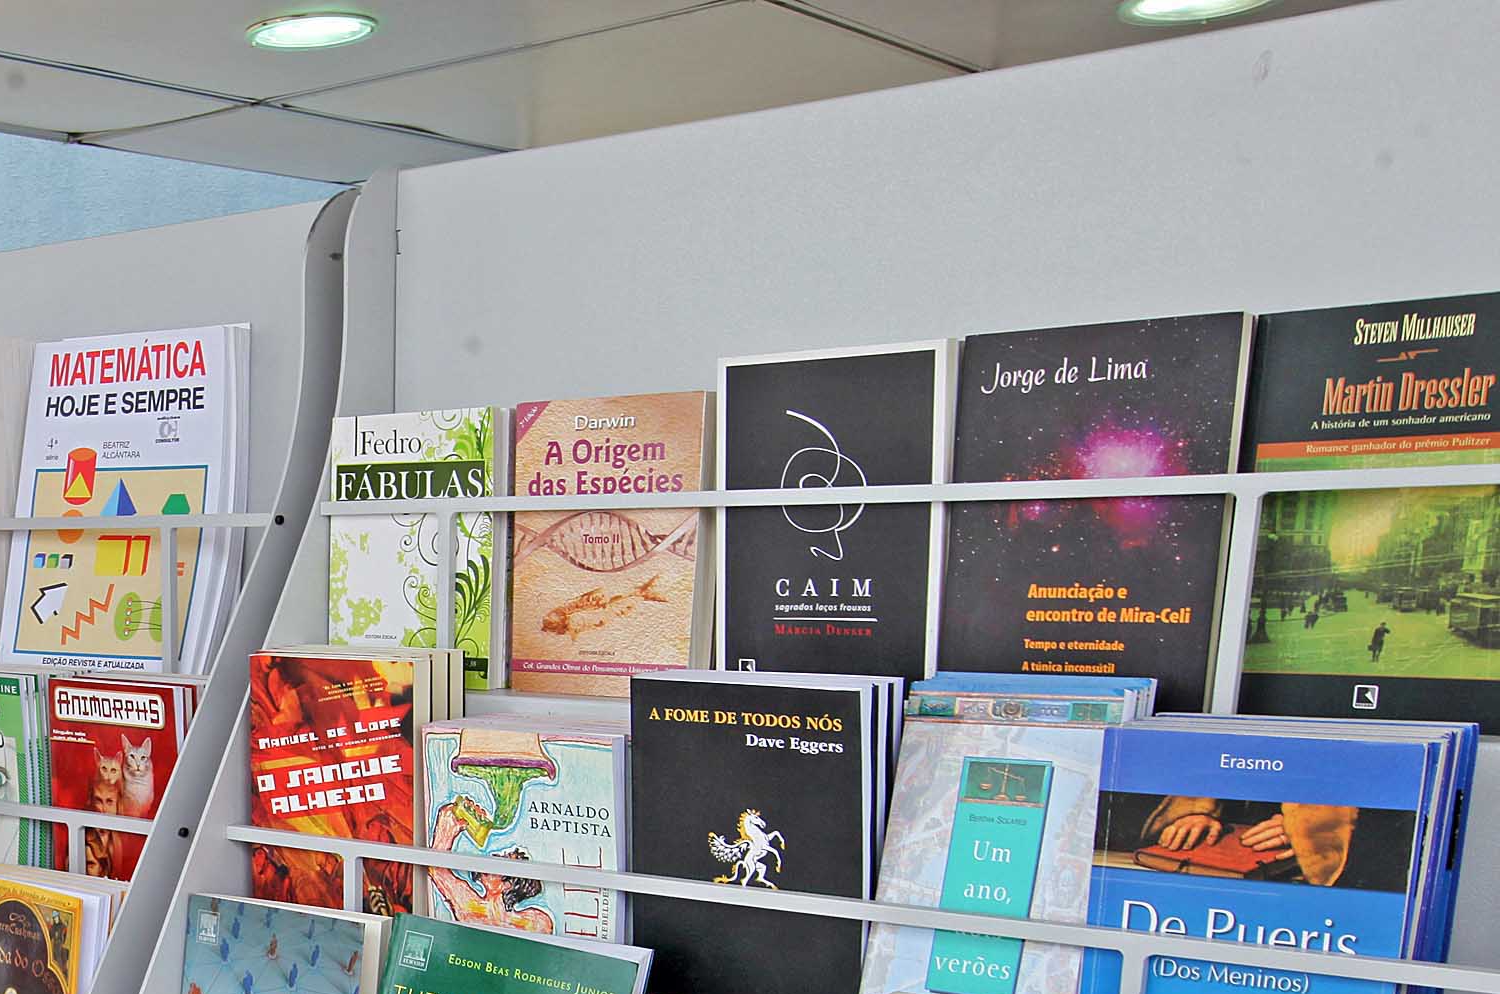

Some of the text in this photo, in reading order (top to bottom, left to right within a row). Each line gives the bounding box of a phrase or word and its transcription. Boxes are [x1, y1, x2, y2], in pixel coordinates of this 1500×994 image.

[1354, 312, 1475, 345] STEVEN MILLHAUSER
[50, 339, 206, 387] MATEMÁTICA
[981, 357, 1148, 393] Jorge de Lima
[46, 387, 204, 417] HOJE E SEMPRE
[1322, 368, 1495, 416] Martin Dressler
[574, 414, 635, 431] Darwin
[1311, 413, 1491, 429] A história de um sonhador americano
[361, 430, 422, 455] Fedro
[1399, 439, 1411, 449] do
[1452, 435, 1490, 447] Pulitzer
[544, 439, 665, 470] A Origem
[339, 464, 484, 500] FÁBULAS
[528, 470, 683, 496] das Espécies
[583, 534, 620, 546] Tomo II
[776, 577, 873, 597] CAIM
[1028, 582, 1127, 601] Anunciação e
[1026, 605, 1190, 624] encontro de Mira-Celi
[1024, 639, 1124, 653] Tempo e eternidade
[42, 657, 68, 668] EDIÇÃO
[103, 660, 144, 670] ATUALIZADA
[58, 691, 160, 724] ANIMORPHS
[650, 708, 842, 731] A FOME DE TODOS NÓS
[746, 734, 843, 755] Dave Eggers
[257, 755, 401, 792] O SANGUE
[1220, 753, 1283, 772] Erasmo
[271, 783, 385, 814] ALHEIO
[528, 801, 609, 819] ARNALDO
[531, 817, 612, 838] BAPTISTA
[973, 840, 1011, 864] Um
[963, 882, 1011, 904] ano,
[1122, 900, 1187, 937] De
[448, 954, 481, 972] EDSON
[485, 961, 509, 976] BEAS
[514, 968, 571, 993] RODRIGUES
[935, 955, 1011, 980] verões
[1153, 958, 1309, 994] (Dos Meninos)
